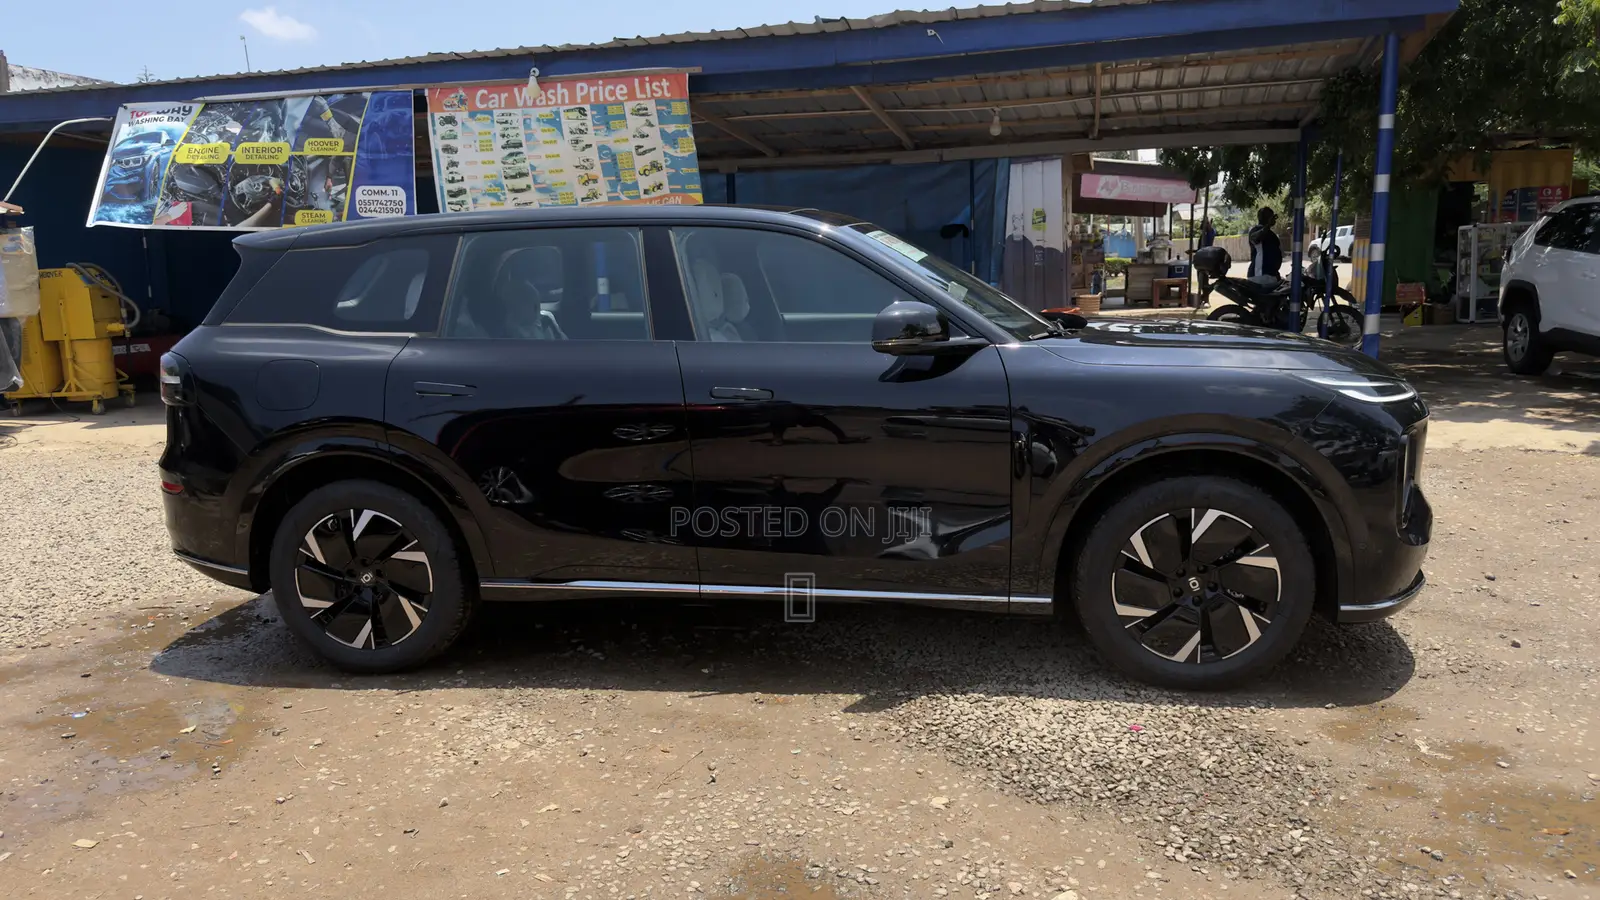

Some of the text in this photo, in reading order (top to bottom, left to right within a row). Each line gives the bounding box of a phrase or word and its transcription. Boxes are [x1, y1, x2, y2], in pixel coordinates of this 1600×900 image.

[475, 76, 671, 109] Car Wash Price List
[128, 116, 165, 127] WASHING
[187, 146, 220, 154] ENGINE
[241, 146, 283, 154] INTERIOR
[186, 153, 220, 161] DETAILING
[357, 199, 404, 207] 0551742750
[358, 206, 404, 215] 0244215901
